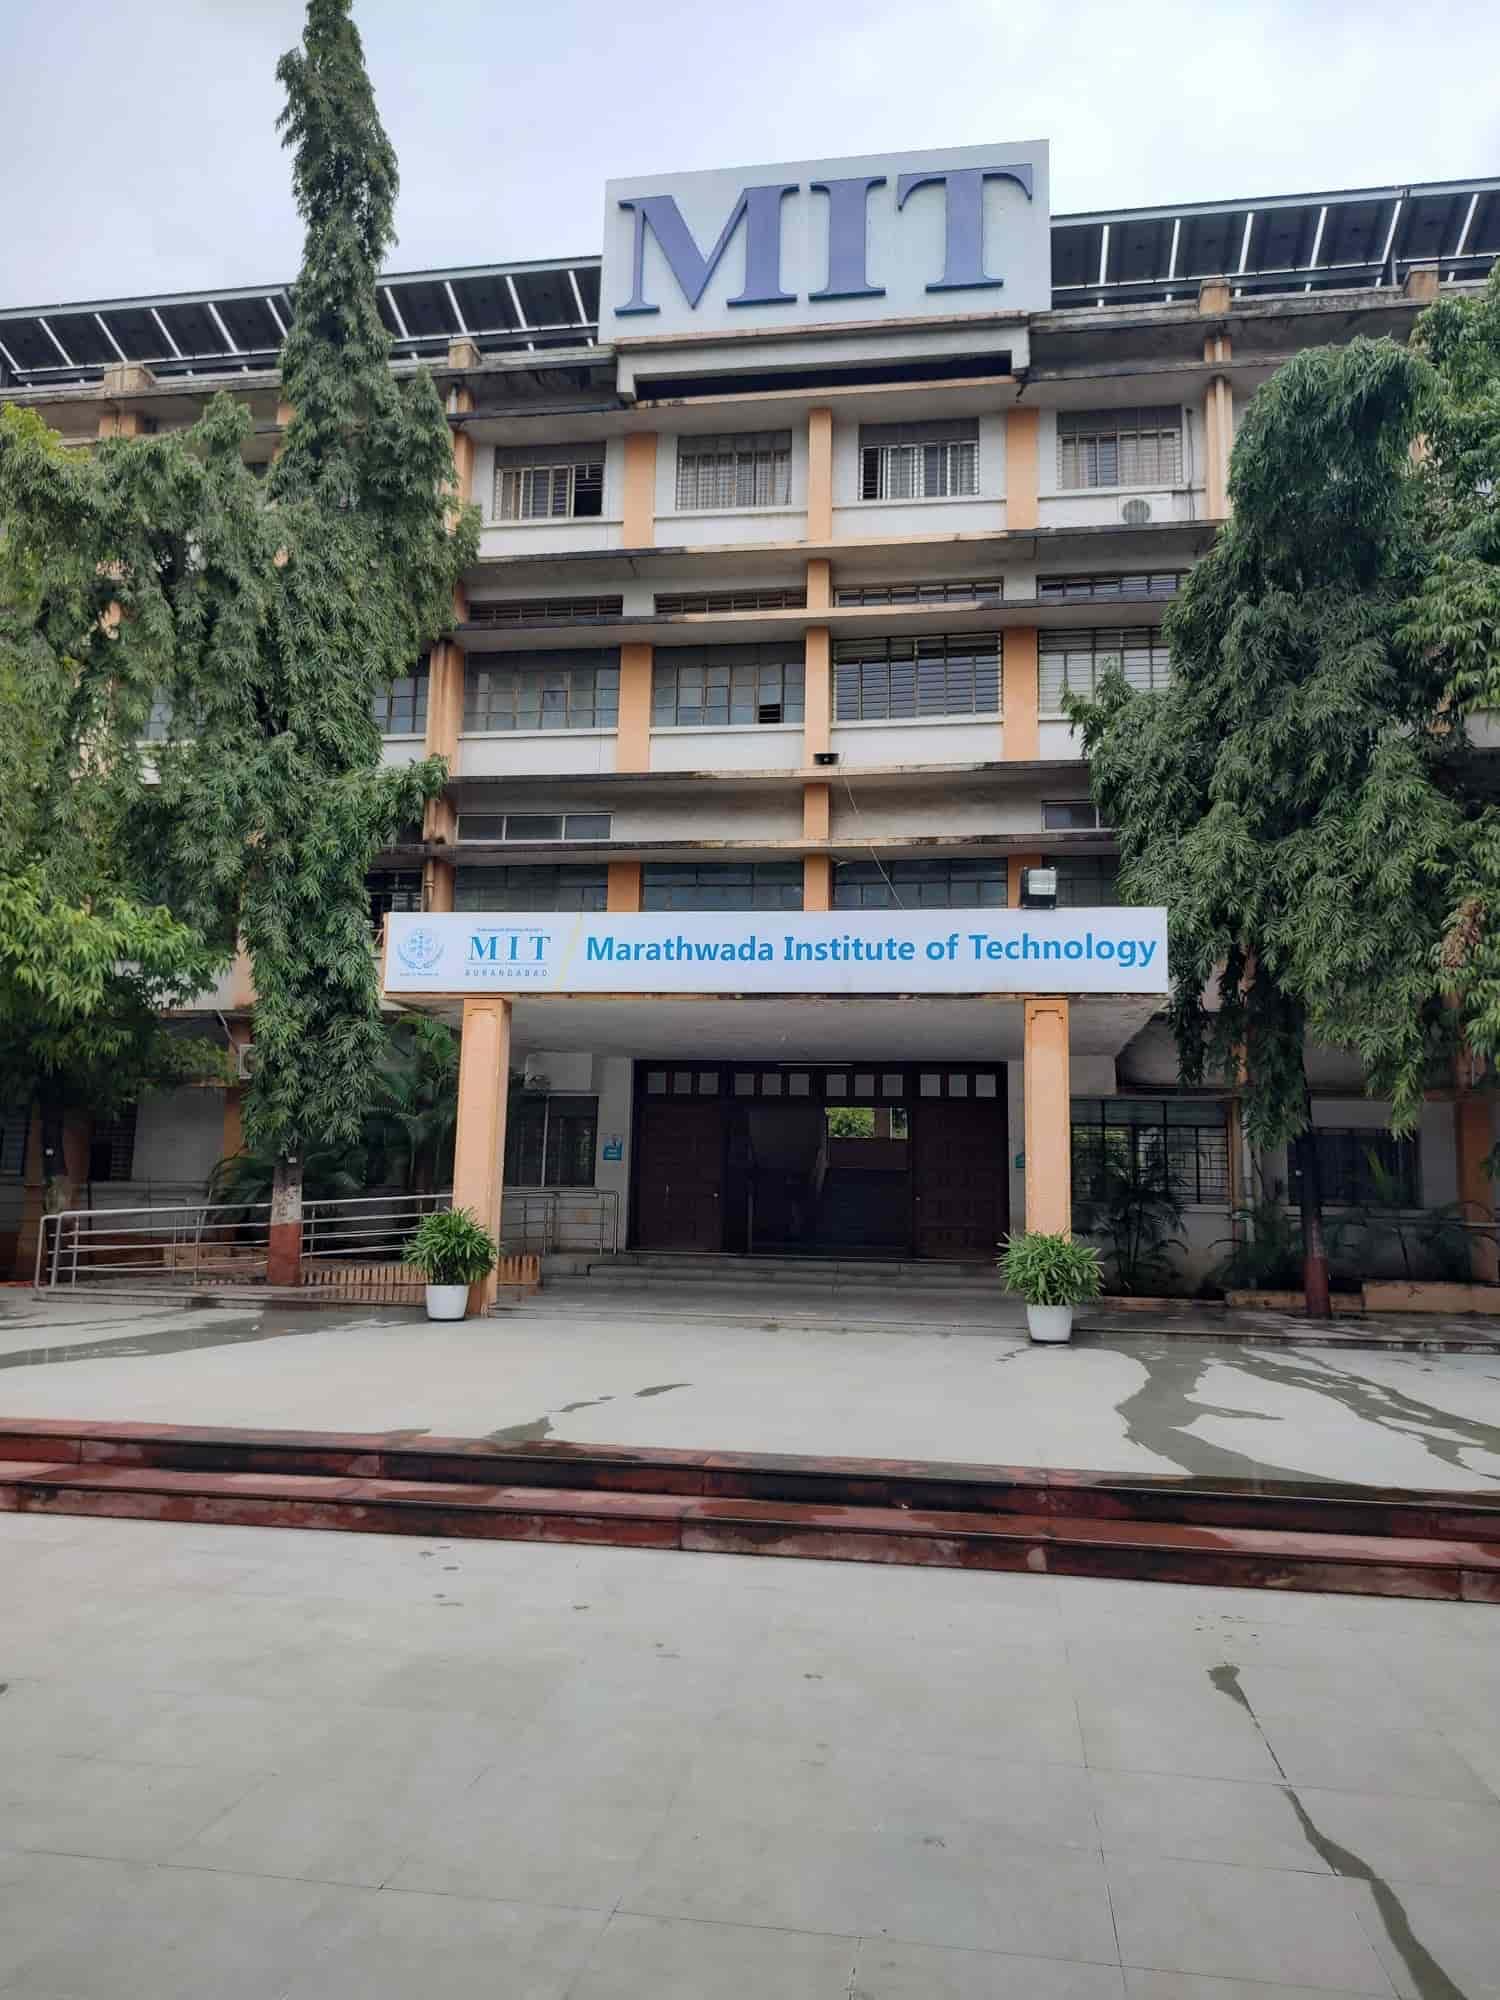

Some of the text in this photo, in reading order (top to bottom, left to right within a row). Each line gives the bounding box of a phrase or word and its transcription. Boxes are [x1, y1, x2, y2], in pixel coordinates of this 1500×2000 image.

[614, 163, 1033, 316] MIT
[468, 936, 552, 960] MIT
[586, 932, 1157, 967] Marathwada Institute of Technology
